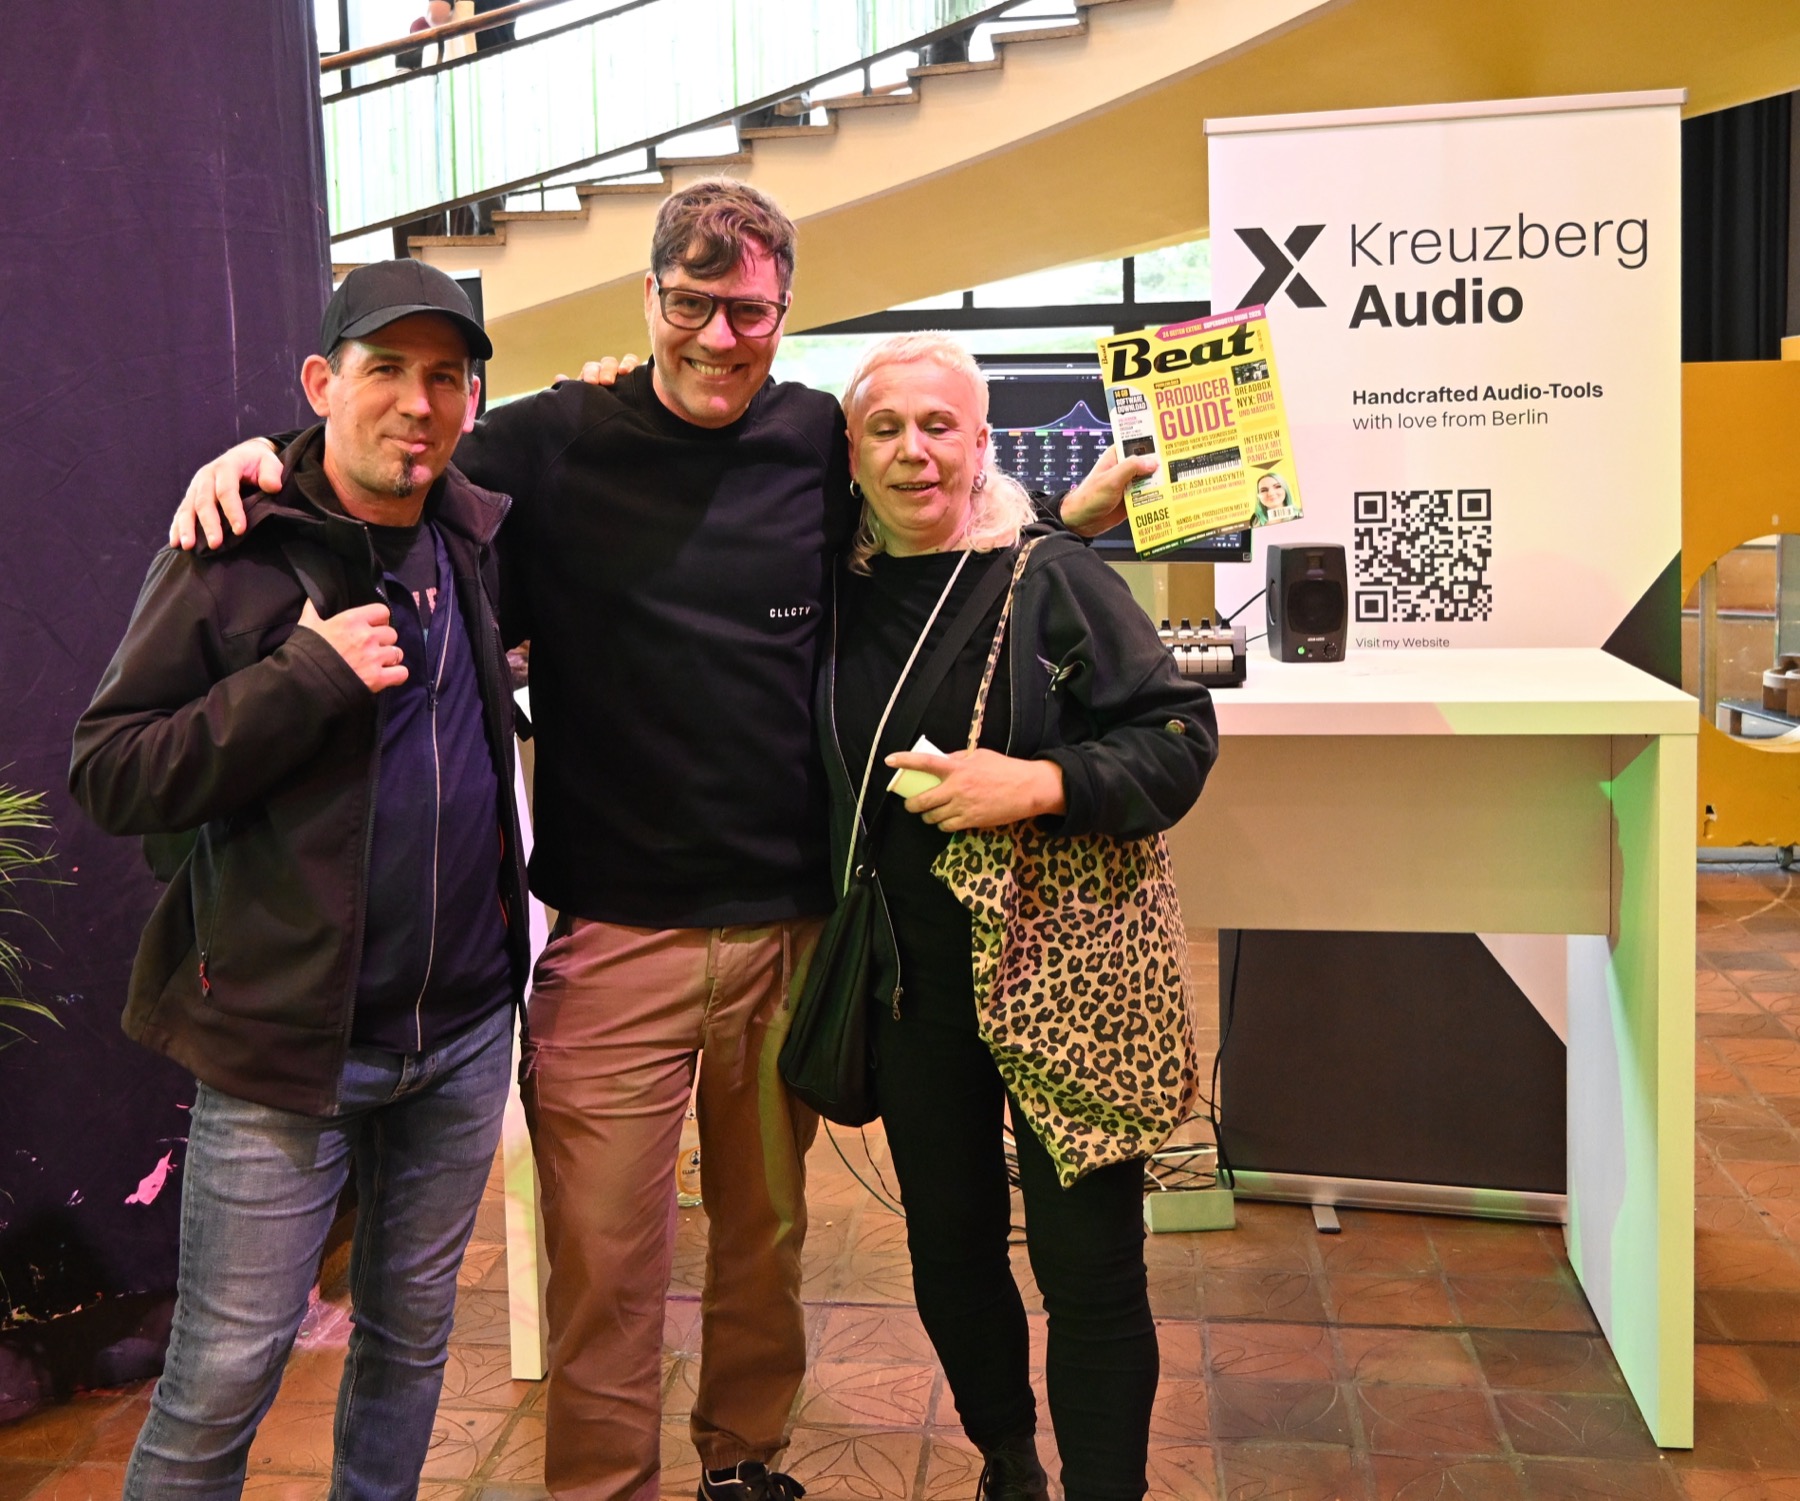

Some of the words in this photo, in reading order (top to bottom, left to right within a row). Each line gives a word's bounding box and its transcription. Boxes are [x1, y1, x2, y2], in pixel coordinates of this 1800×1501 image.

[1350, 212, 1649, 270] Kreuzberg
[1348, 276, 1525, 330] Audio
[1100, 344, 1108, 365] Beat
[1107, 322, 1255, 383] Beat
[1155, 377, 1230, 411] PRODUCER
[1234, 380, 1272, 396] DREADBOX
[1353, 385, 1478, 406] Handcrafted
[1482, 381, 1604, 402] Audio-Tools
[1116, 395, 1143, 407] SOFTWARE
[1117, 402, 1146, 414] DOWNLOAD
[1236, 394, 1256, 408] NYX:
[1256, 390, 1274, 404] ROH
[1158, 397, 1236, 442] GUIDE
[1239, 408, 1251, 417] UND
[1353, 413, 1392, 430] with
[1398, 412, 1437, 429] love
[1442, 410, 1486, 428] from
[1492, 408, 1548, 426] Berlin
[1243, 429, 1280, 445] INTERVIEW
[1245, 446, 1255, 454] IM
[1256, 442, 1270, 452] TALK
[1271, 439, 1281, 448] MIT
[1247, 452, 1268, 463] PANIC
[1269, 448, 1284, 458] GIRL
[1171, 483, 1188, 493] TEST:
[1189, 479, 1204, 489] ASM
[1205, 470, 1245, 486] LEVIASYNTH
[1135, 507, 1171, 528] CUBASE
[1138, 526, 1154, 537] HEAVY
[1154, 521, 1171, 532] METAL
[1355, 637, 1380, 648] Visit
[1382, 639, 1400, 650] my
[1402, 636, 1450, 648] Website
